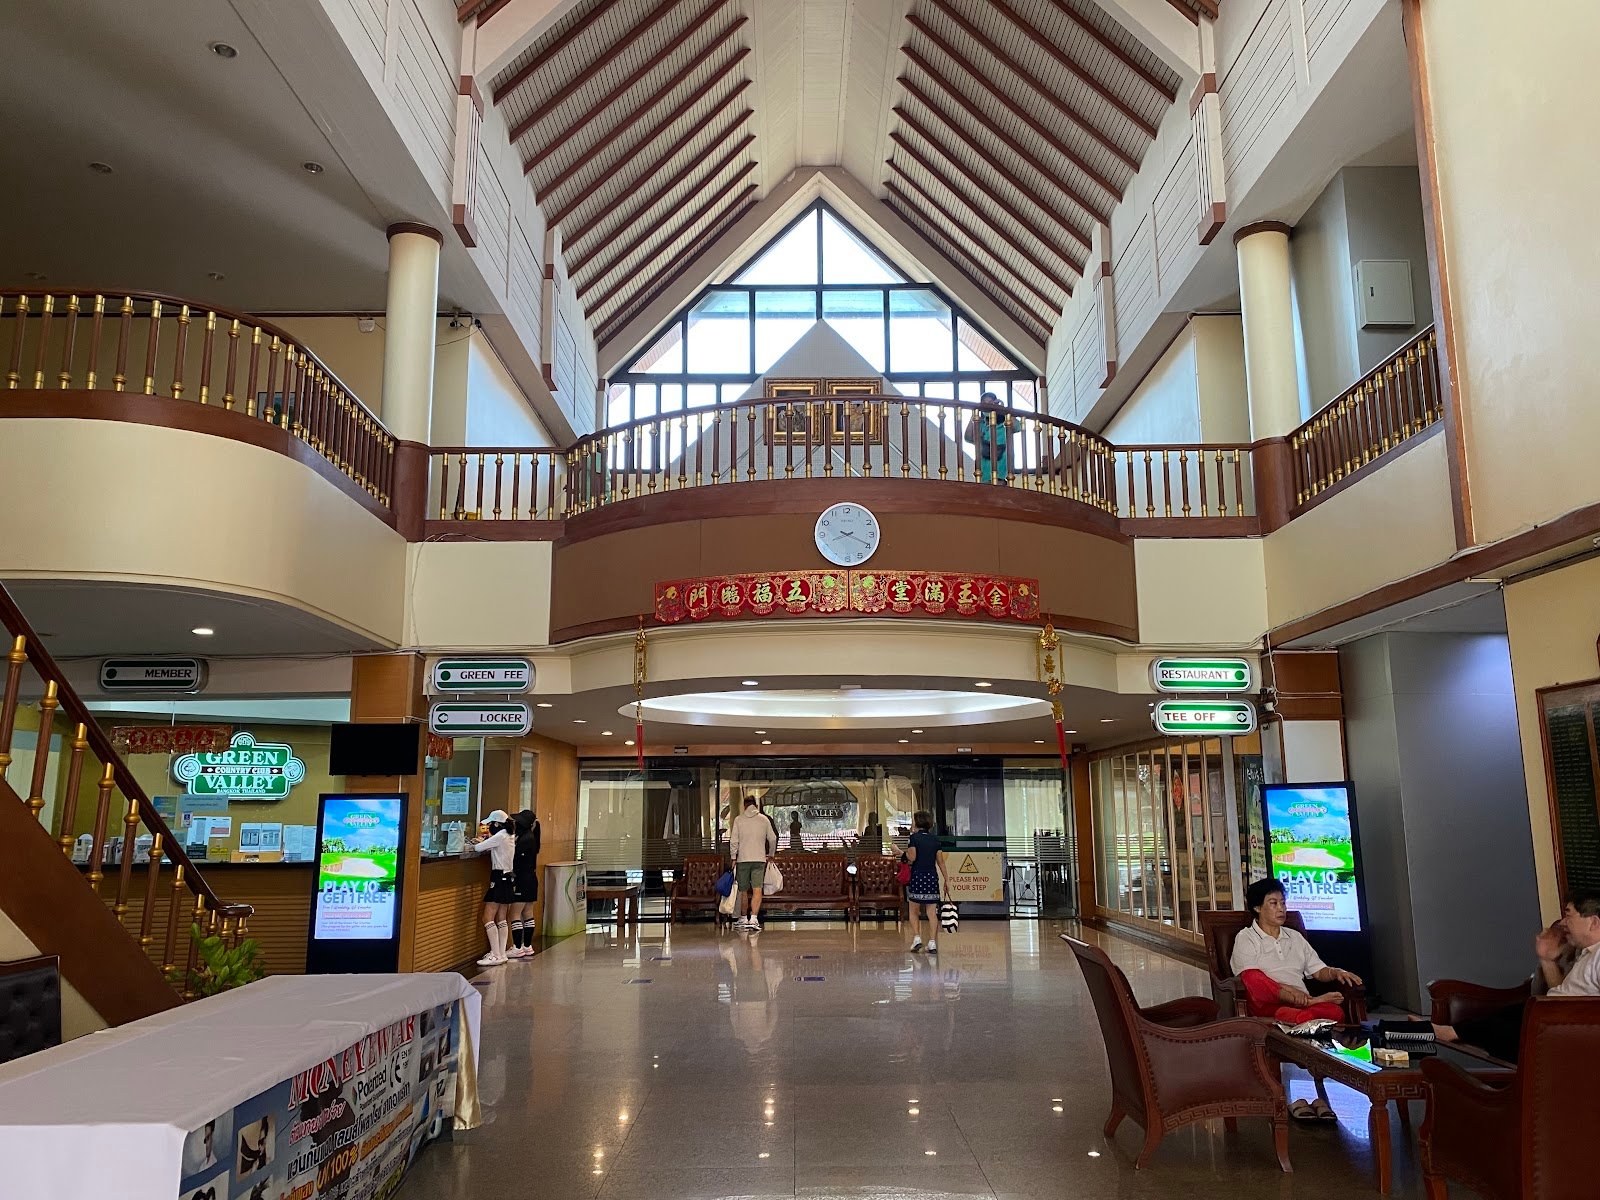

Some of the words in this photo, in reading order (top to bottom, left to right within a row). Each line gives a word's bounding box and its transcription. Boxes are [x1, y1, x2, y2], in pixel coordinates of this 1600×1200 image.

[144, 669, 192, 678] MEMBER
[460, 670, 495, 679] GREEN
[504, 670, 523, 679] FEE
[1161, 669, 1229, 679] RESTAURANT
[480, 713, 522, 723] LOCKER
[1165, 712, 1187, 721] TEE
[1194, 712, 1216, 721] OFF
[205, 750, 279, 765] GREEN
[203, 775, 278, 789] VALLEY
[809, 809, 840, 817] VALLEY
[1279, 870, 1316, 883] PLAY
[1321, 870, 1338, 883] 10
[323, 880, 360, 893] PLAY
[363, 880, 379, 893] 10
[1307, 882, 1313, 894] 1
[323, 892, 347, 903] GET
[349, 892, 354, 903] 1
